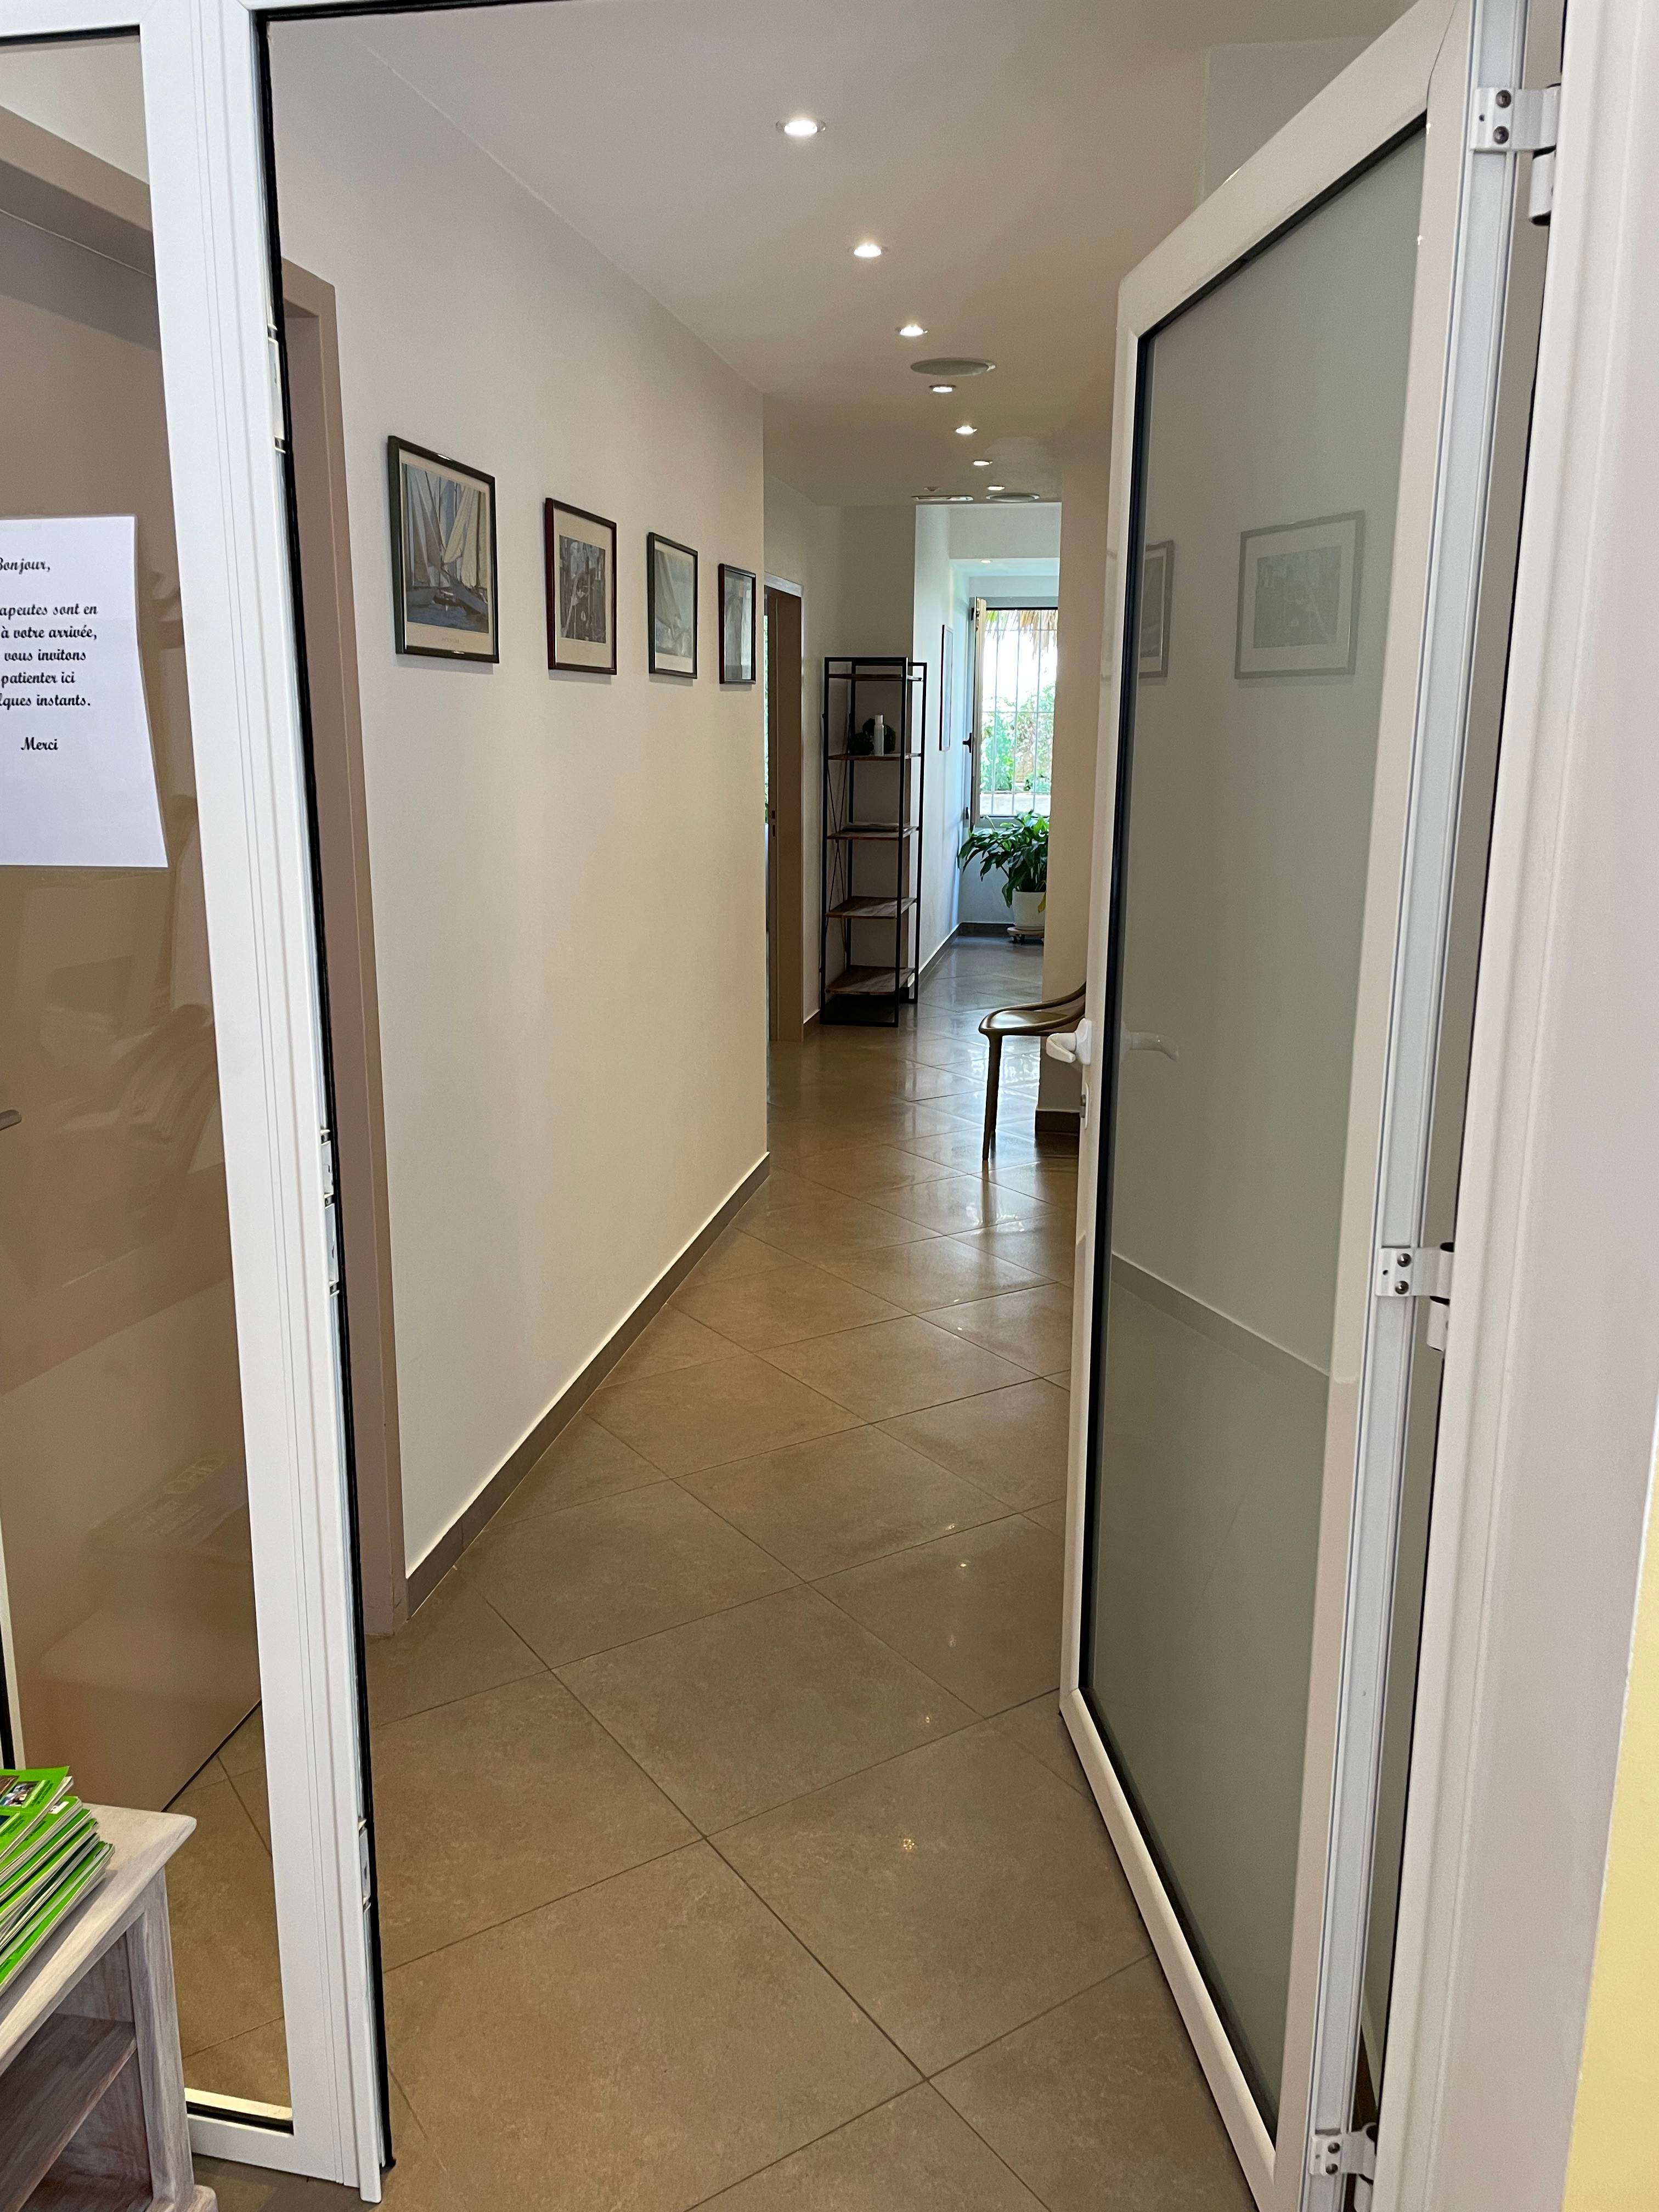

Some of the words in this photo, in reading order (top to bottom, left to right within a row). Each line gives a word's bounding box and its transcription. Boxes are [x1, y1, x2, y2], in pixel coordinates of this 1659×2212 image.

[53, 603, 80, 615] sont
[83, 606, 98, 615] en
[1, 625, 9, 639] à
[13, 627, 44, 639] votre
[49, 624, 97, 640] arrivée,
[4, 652, 33, 661] vous
[38, 648, 86, 661] invitons
[1, 672, 57, 688] patienter
[61, 671, 75, 684] ici
[36, 694, 91, 707] instants.
[21, 736, 59, 751] Merci
